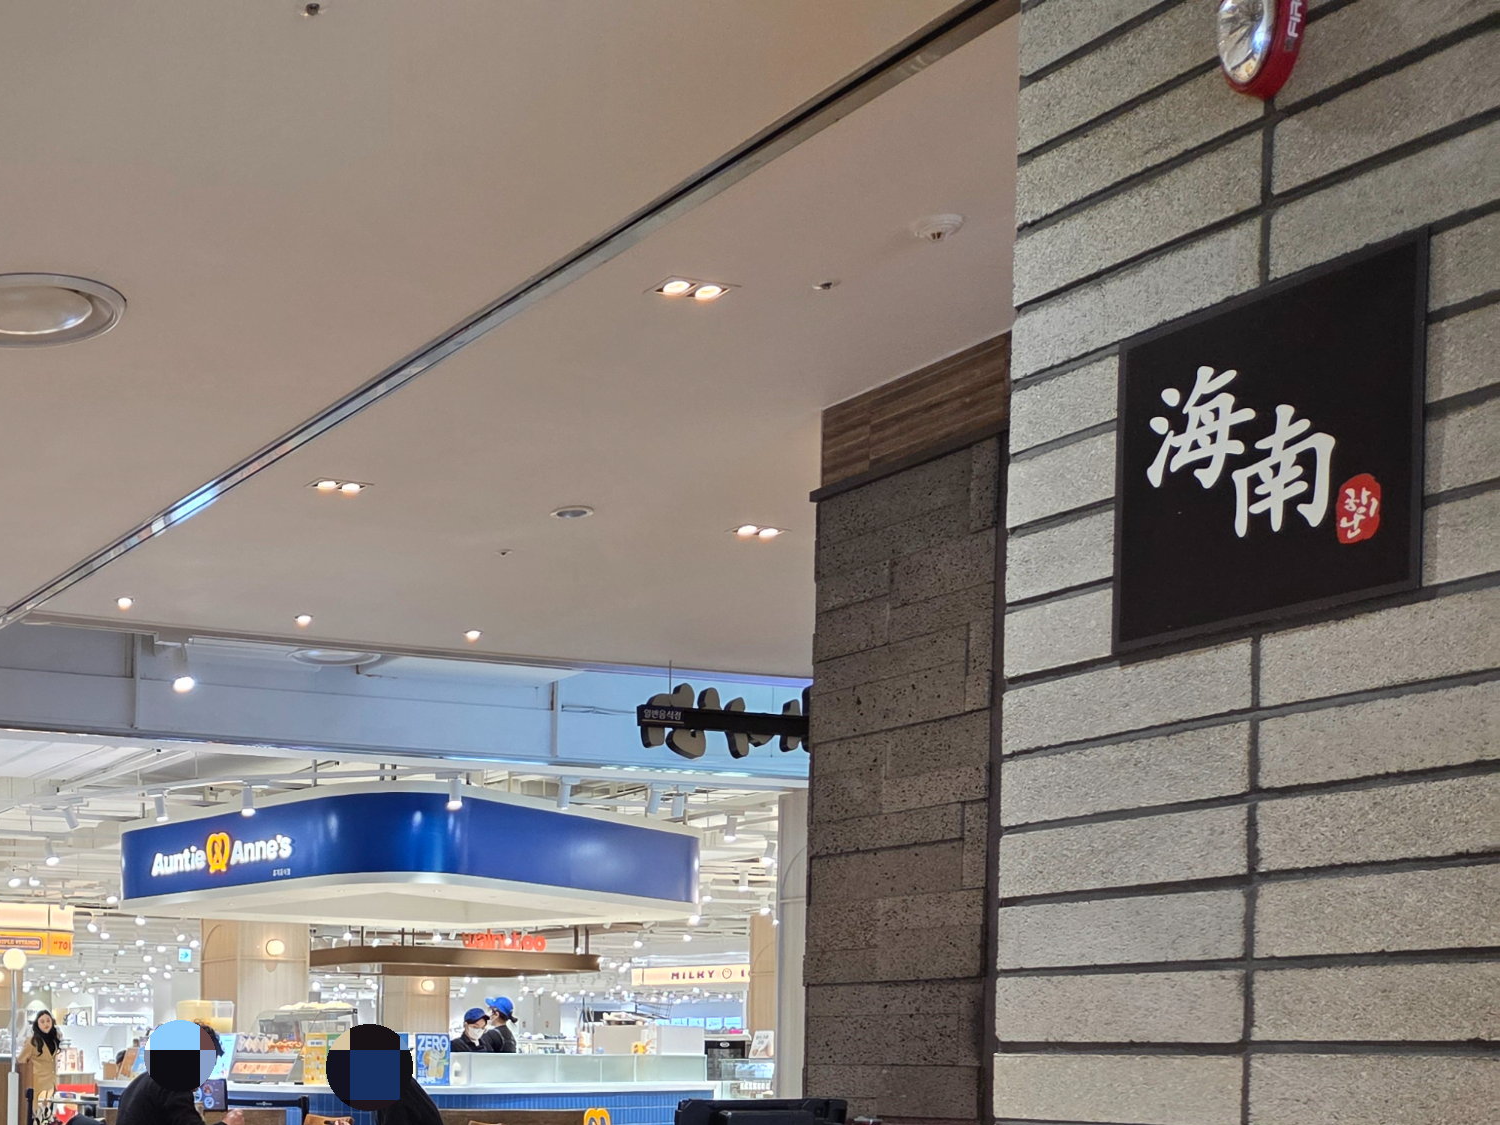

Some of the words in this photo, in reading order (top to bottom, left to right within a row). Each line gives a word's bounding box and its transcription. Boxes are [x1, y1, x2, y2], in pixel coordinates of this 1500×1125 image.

[1288, 0, 1302, 37] FIR
[1146, 366, 1336, 538] 海南
[1340, 487, 1379, 539] 하이난
[643, 708, 682, 721] 일반음식점
[151, 845, 206, 877] Auntie
[230, 834, 292, 865] Anne's
[671, 970, 715, 980] MILKY
[417, 1035, 449, 1052] ZERO
